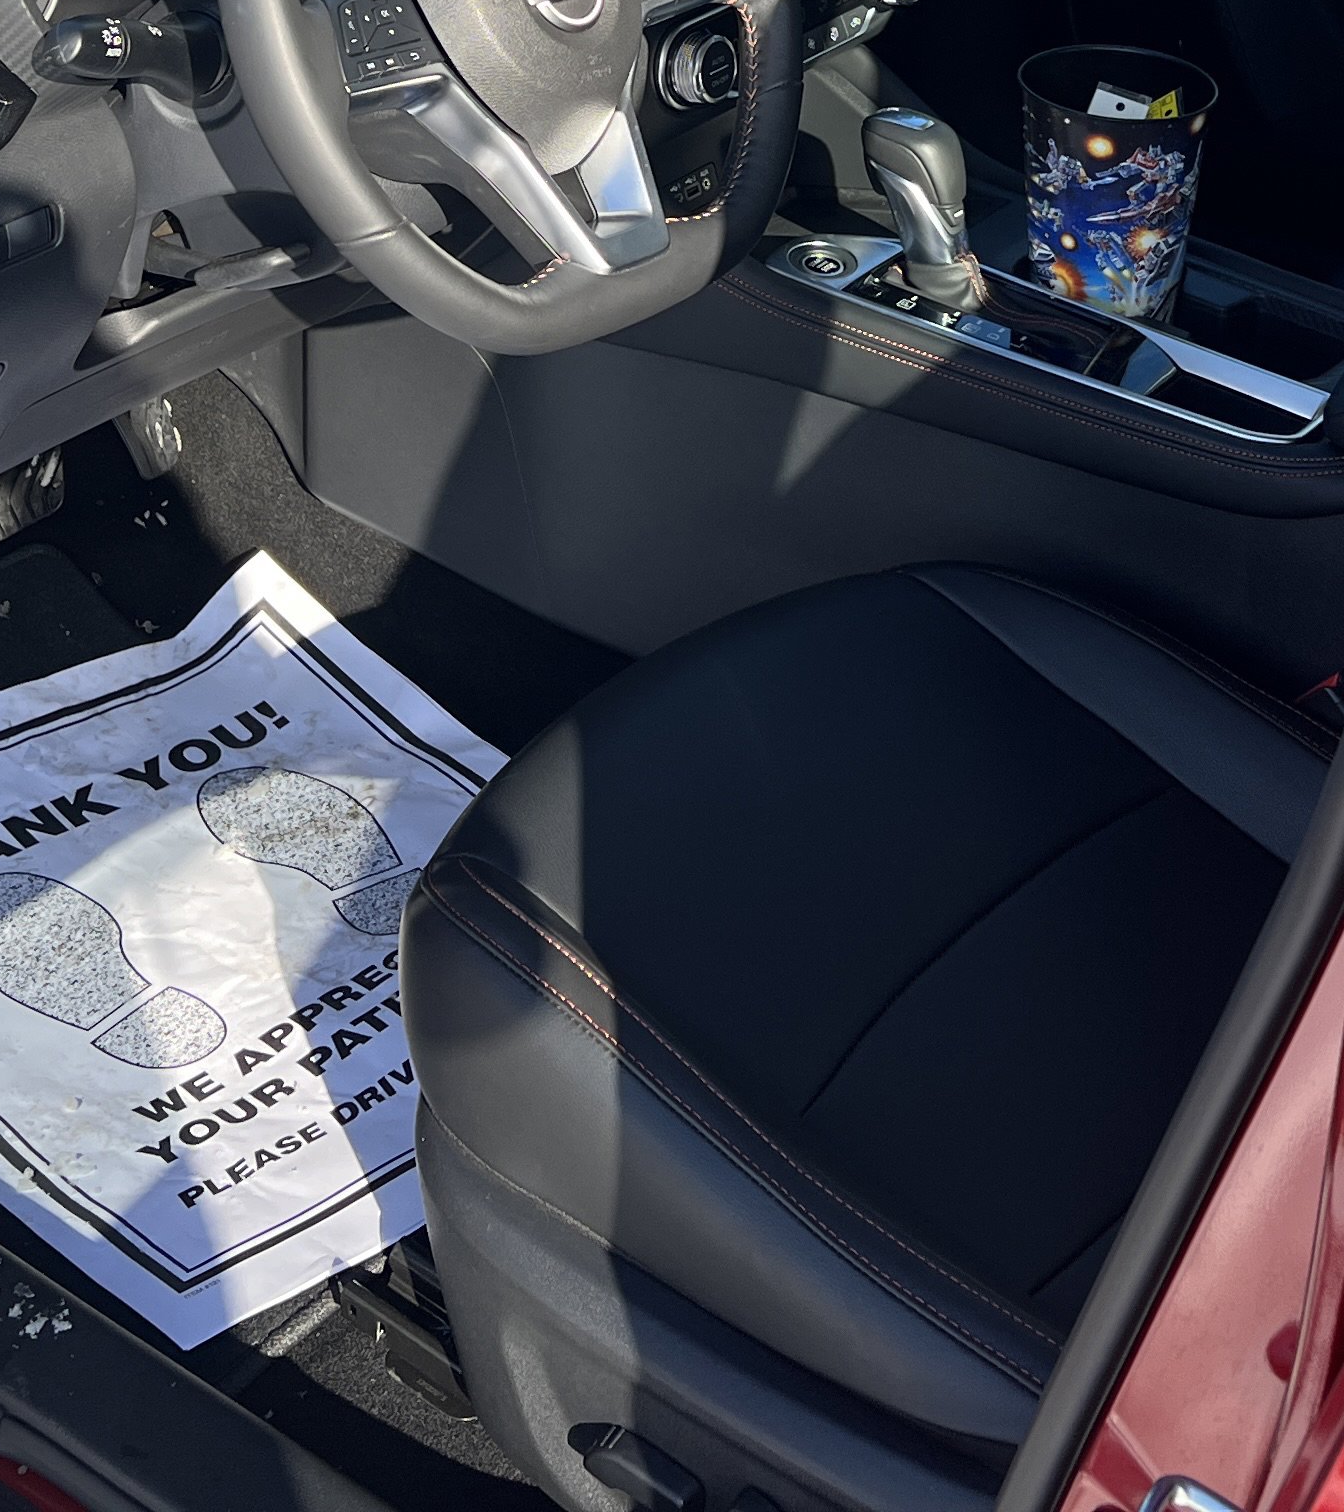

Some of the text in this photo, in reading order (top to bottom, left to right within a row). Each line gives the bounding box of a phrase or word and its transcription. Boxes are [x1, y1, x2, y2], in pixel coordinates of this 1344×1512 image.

[115, 700, 291, 791] YOU!
[132, 1071, 226, 1123] WE
[136, 990, 402, 1164] YOUR PATI
[177, 1121, 328, 1209] PLEASE
